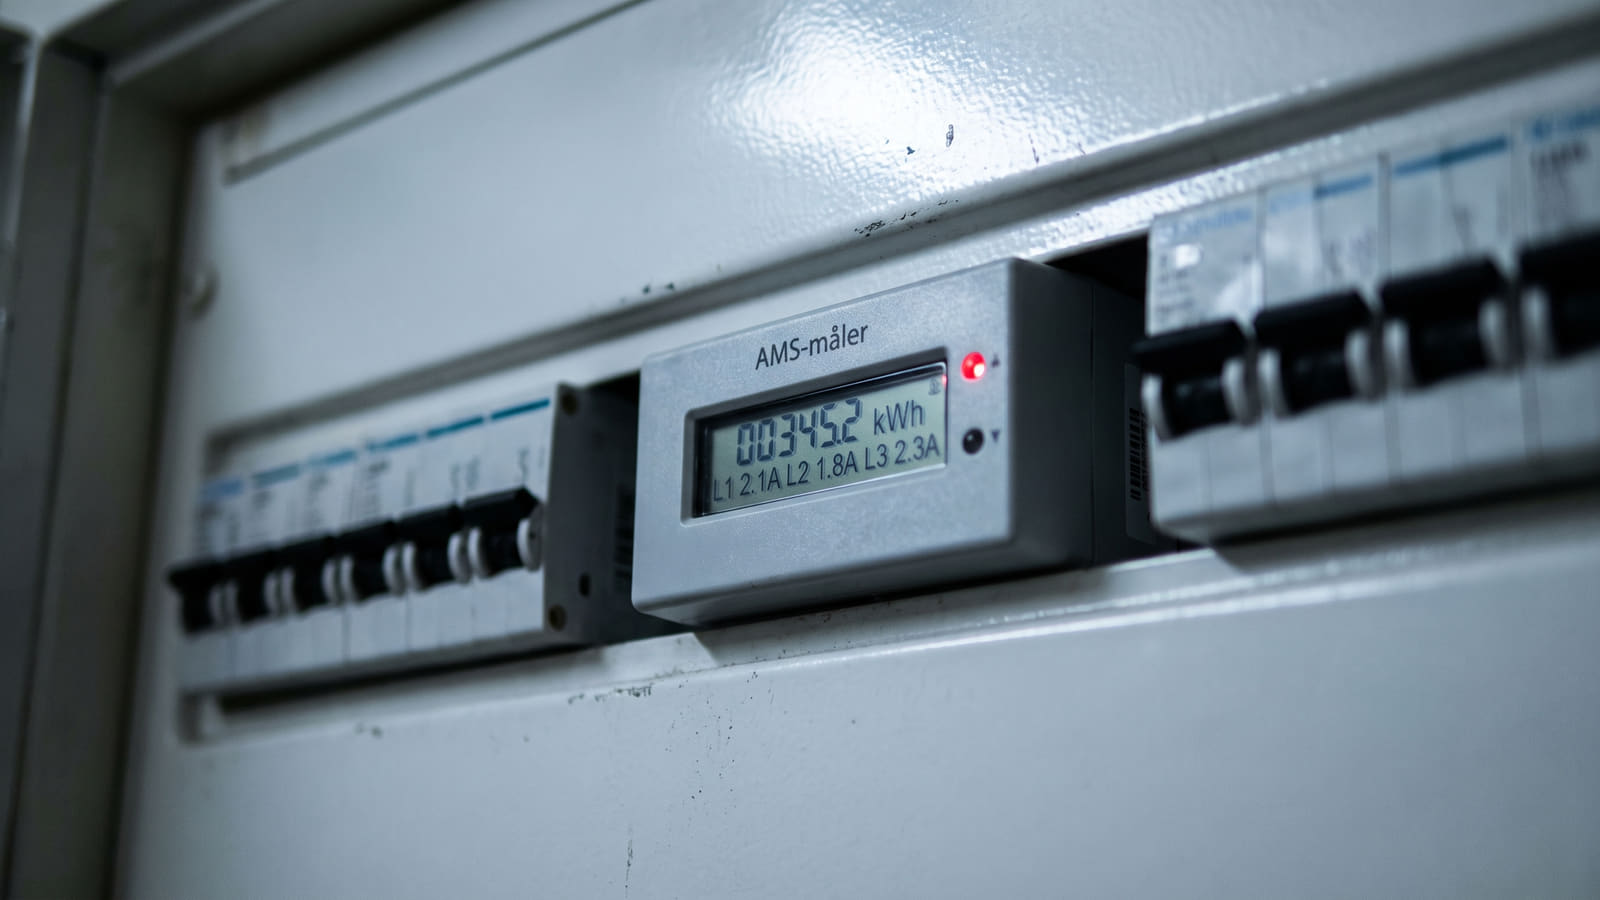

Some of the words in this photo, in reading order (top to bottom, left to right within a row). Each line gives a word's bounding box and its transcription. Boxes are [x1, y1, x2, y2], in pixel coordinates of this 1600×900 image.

[755, 324, 869, 370] AMS-måler
[736, 398, 863, 466] 00345.2
[873, 400, 925, 435] kWh
[713, 477, 733, 501] L1
[740, 468, 780, 496] 2.1A
[786, 461, 809, 487] L2
[817, 451, 858, 479] 1.8A
[864, 445, 888, 470] L3
[894, 433, 940, 464] 2.3A
